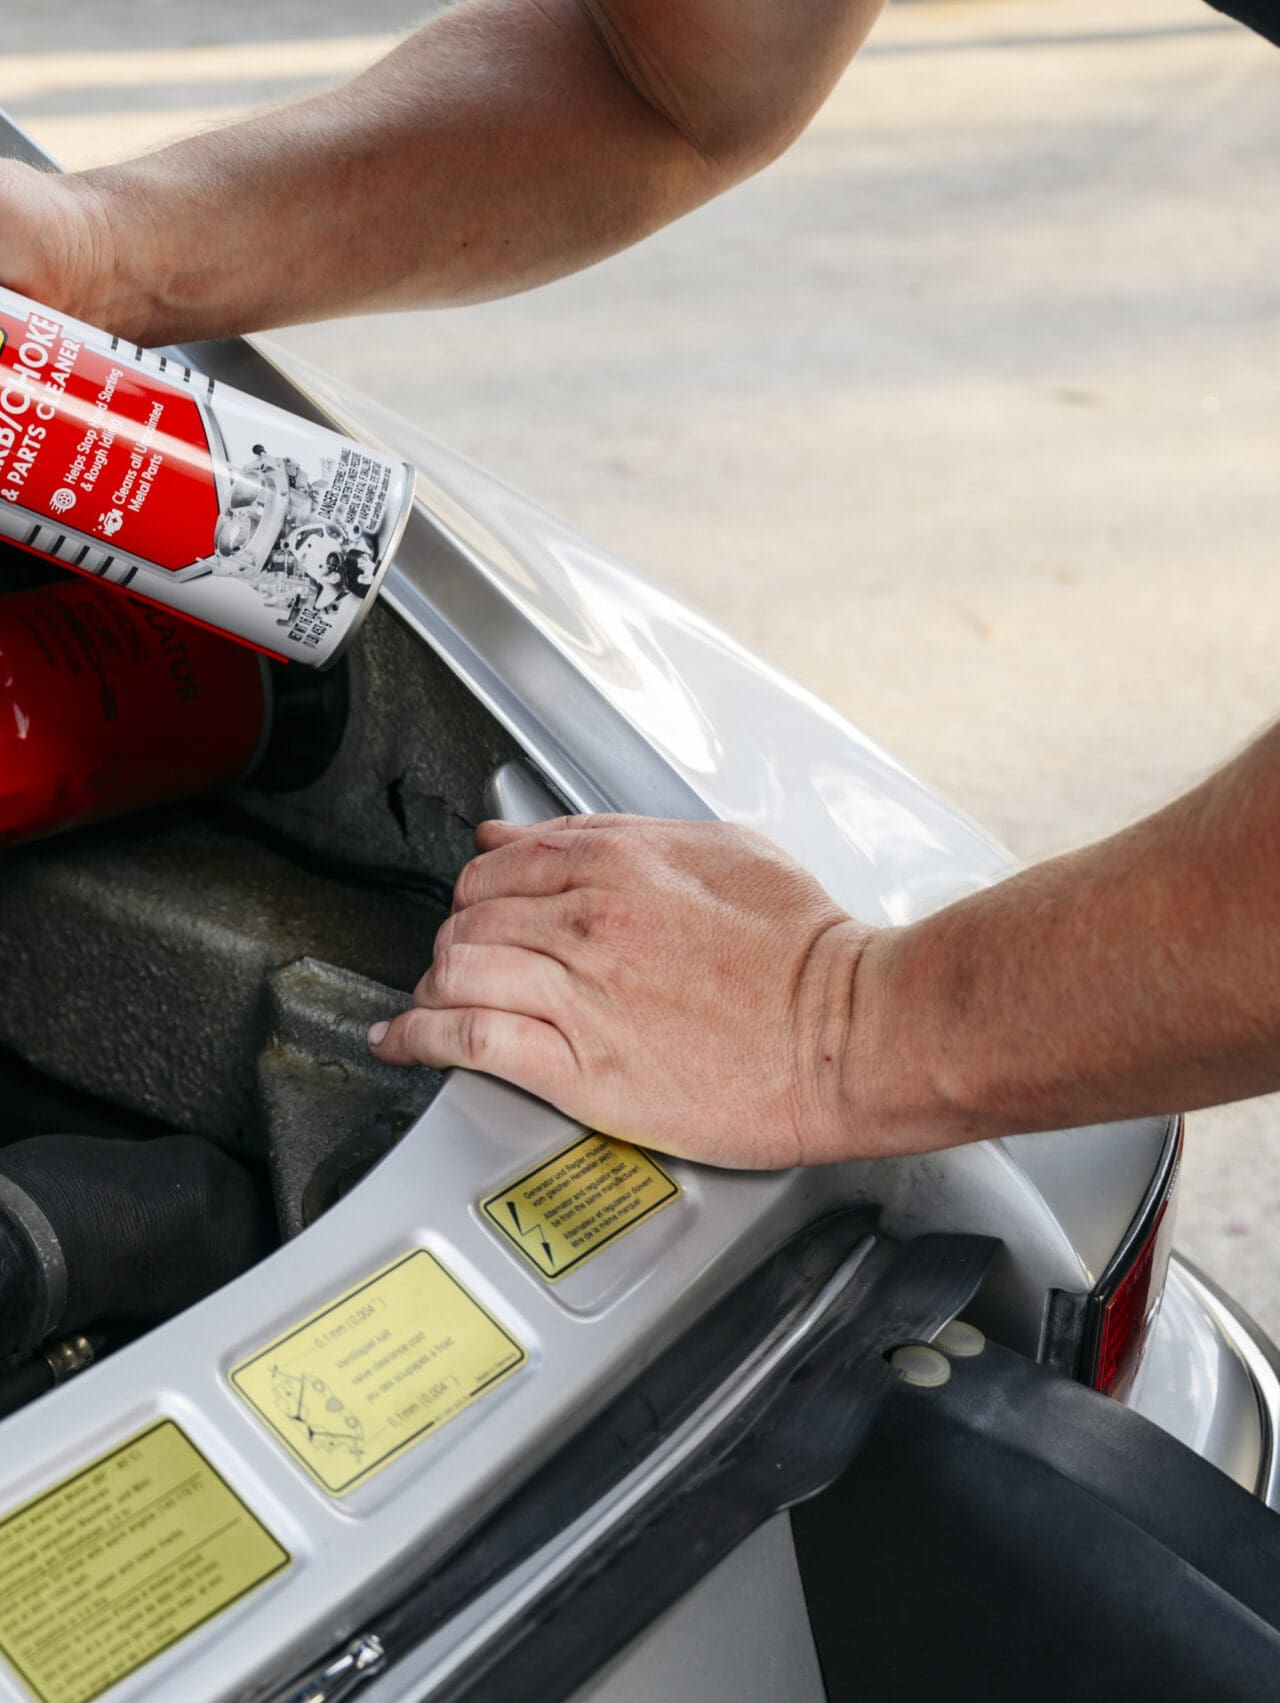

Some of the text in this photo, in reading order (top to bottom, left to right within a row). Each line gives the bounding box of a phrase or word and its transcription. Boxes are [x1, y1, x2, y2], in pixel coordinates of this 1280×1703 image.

[1, 338, 81, 502] & PARTS CLEANER
[63, 451, 88, 485] Helps
[76, 427, 99, 454] Stop
[98, 366, 124, 402] Starting
[79, 480, 93, 492] &
[84, 446, 111, 482] Rough
[111, 466, 137, 506] Cleans
[126, 451, 143, 469] all
[128, 451, 163, 513] Metal Parts
[128, 597, 196, 702] LATOR
[523, 1175, 555, 1200] Generator
[553, 1167, 567, 1180] und
[564, 1154, 587, 1174] Regler
[531, 1194, 546, 1208] vom
[545, 1176, 572, 1200] gleichen
[569, 1158, 600, 1182] Hersteller
[542, 1161, 626, 1220] Alternator and regulator must
[550, 1217, 561, 1228] be
[558, 1207, 576, 1222] from
[573, 1200, 586, 1212] the
[584, 1190, 602, 1205] same
[563, 1175, 653, 1240] Alternateur et régulateur doivent
[570, 1234, 585, 1248] être
[582, 1229, 593, 1239] de
[591, 1224, 600, 1234] la
